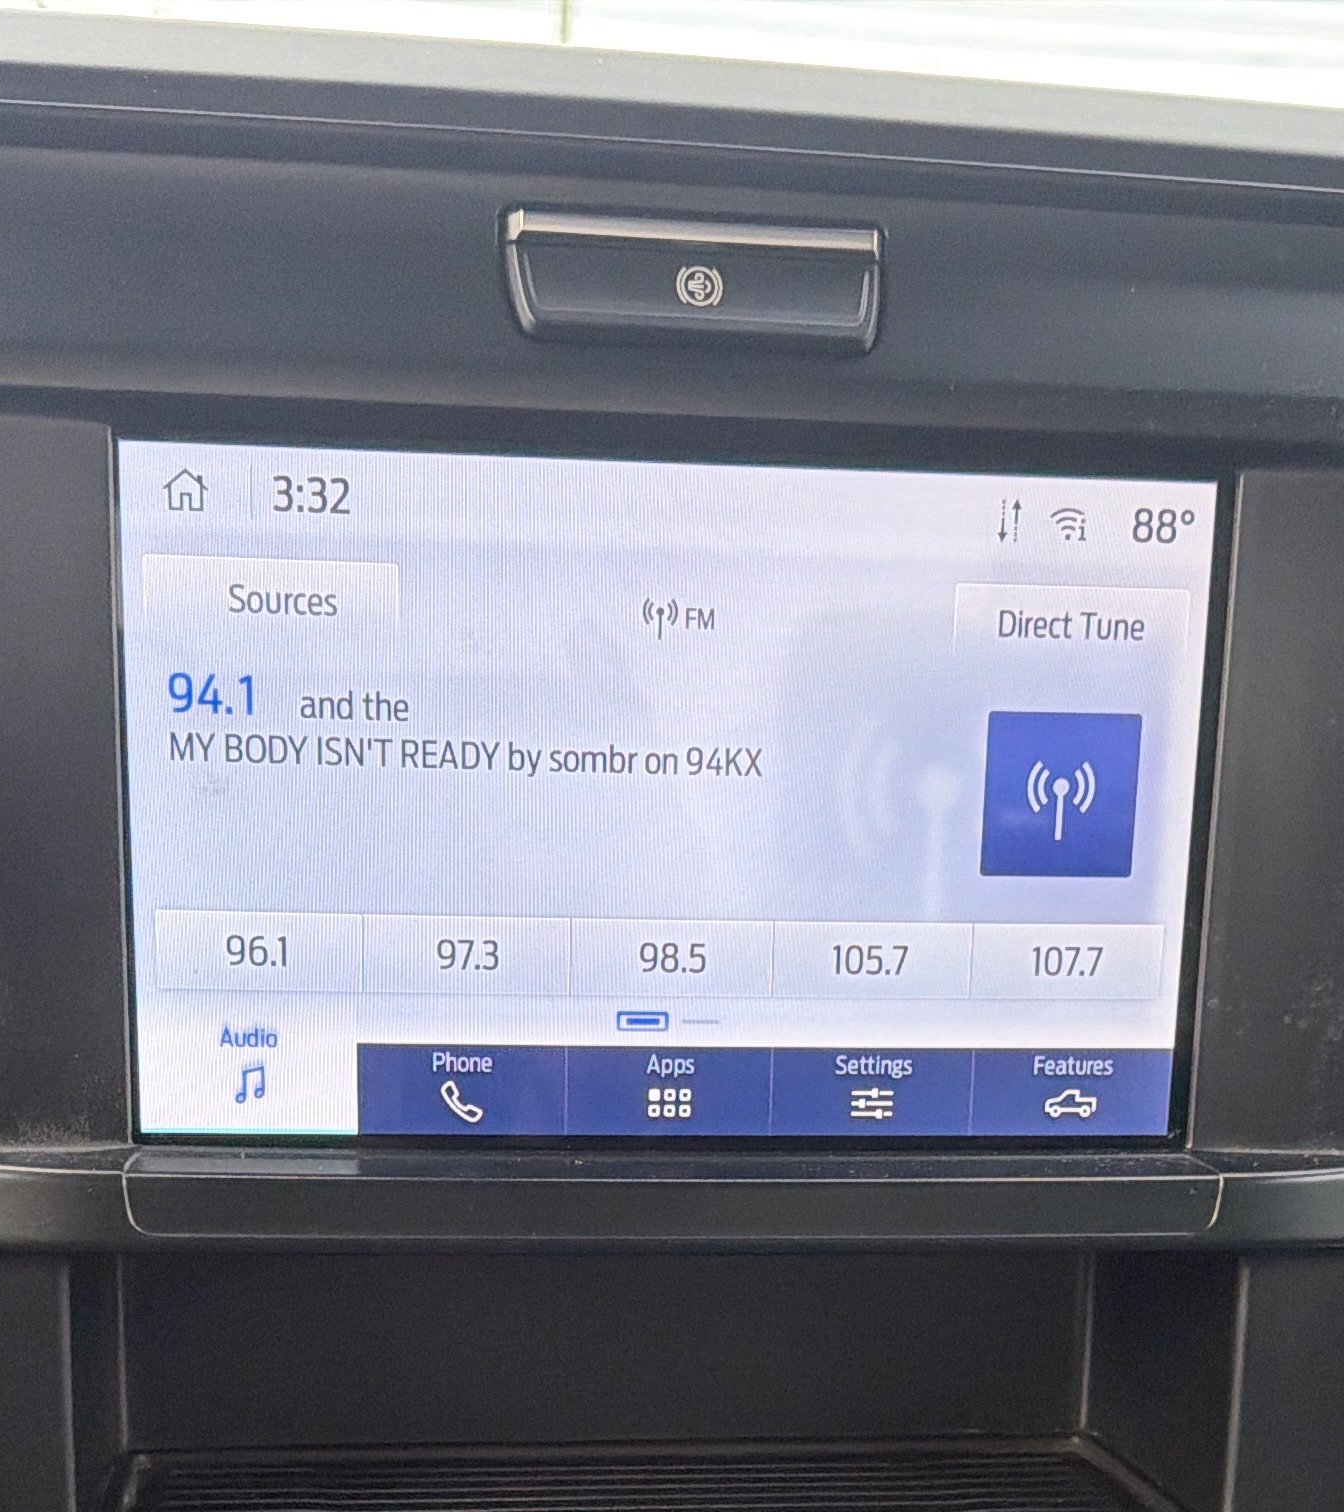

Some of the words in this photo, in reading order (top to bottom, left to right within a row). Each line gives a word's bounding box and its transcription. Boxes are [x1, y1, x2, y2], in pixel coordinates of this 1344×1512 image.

[272, 474, 351, 515] 3:32
[228, 584, 338, 617] Sources
[685, 608, 716, 630] FM
[998, 610, 1073, 640] Direct
[1081, 613, 1145, 641] Tune
[168, 672, 254, 716] 94.1
[300, 691, 354, 721] and
[362, 692, 409, 722] the
[169, 732, 215, 763] MY
[225, 734, 307, 766] BODY
[316, 737, 393, 768] ISN'T
[401, 739, 500, 771] READY
[508, 743, 541, 778] by
[550, 744, 637, 776] sombr
[645, 753, 678, 776] on
[686, 747, 763, 778] 94KX
[225, 934, 288, 968] 96.1
[436, 939, 499, 972] 97.3
[639, 941, 707, 974] 98.5
[831, 944, 909, 977] 105.7
[1031, 945, 1104, 977] 107.7
[219, 1026, 279, 1048] Audio
[432, 1051, 493, 1073] Phone
[646, 1054, 695, 1079] Apps
[835, 1054, 913, 1079] Settings
[1033, 1055, 1114, 1077] Features
